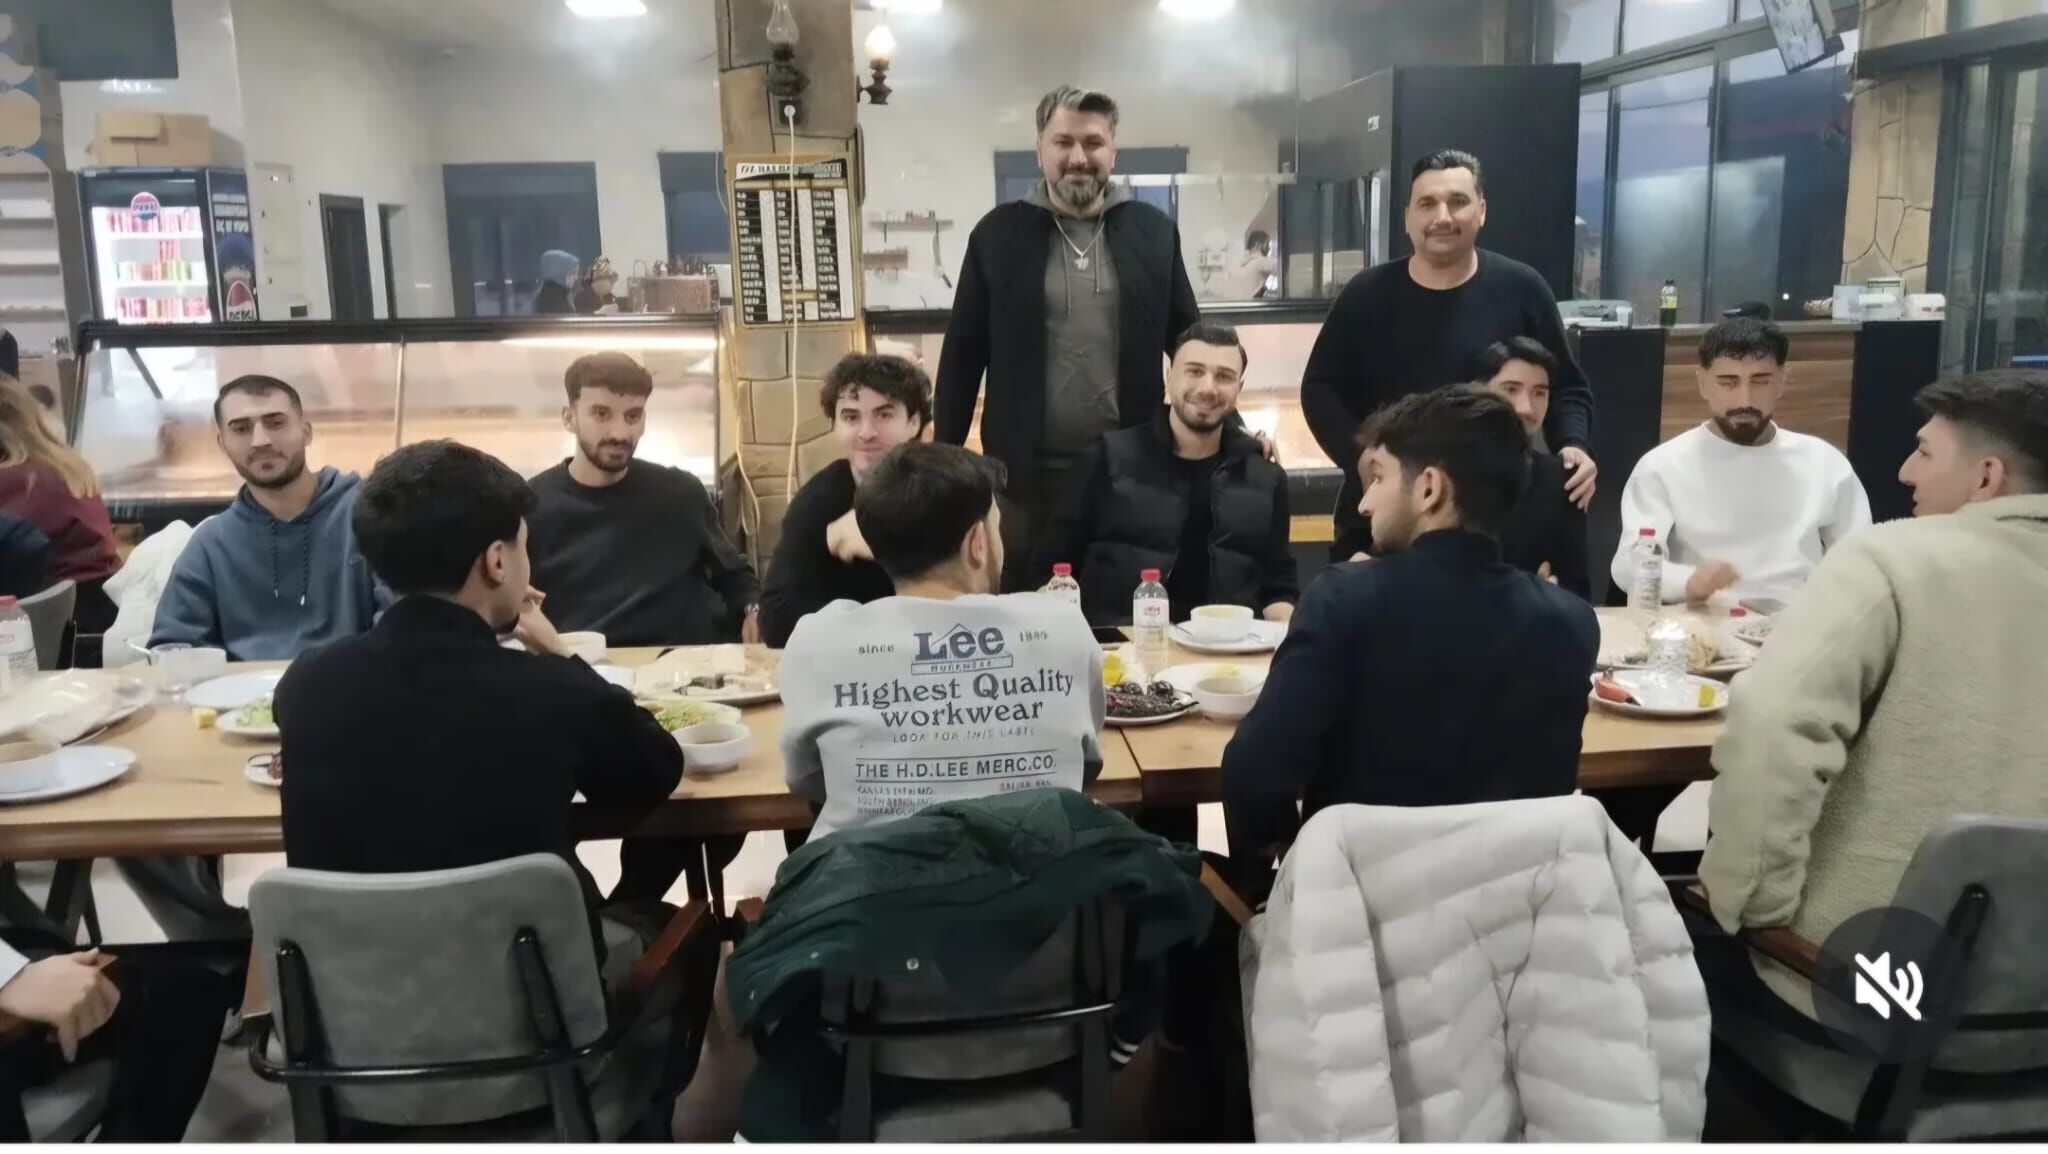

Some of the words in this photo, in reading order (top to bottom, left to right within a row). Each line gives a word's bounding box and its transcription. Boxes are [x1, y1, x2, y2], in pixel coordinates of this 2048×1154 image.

[858, 643, 894, 655] since
[913, 626, 1005, 661] Lee
[834, 677, 961, 709] Highest
[972, 670, 1074, 701] Quality
[881, 700, 1044, 728] workwear
[892, 732, 926, 744] LOOK
[855, 763, 889, 778] THE
[896, 761, 969, 778] H.D.LEE
[976, 754, 1057, 776] MERC.CO.
